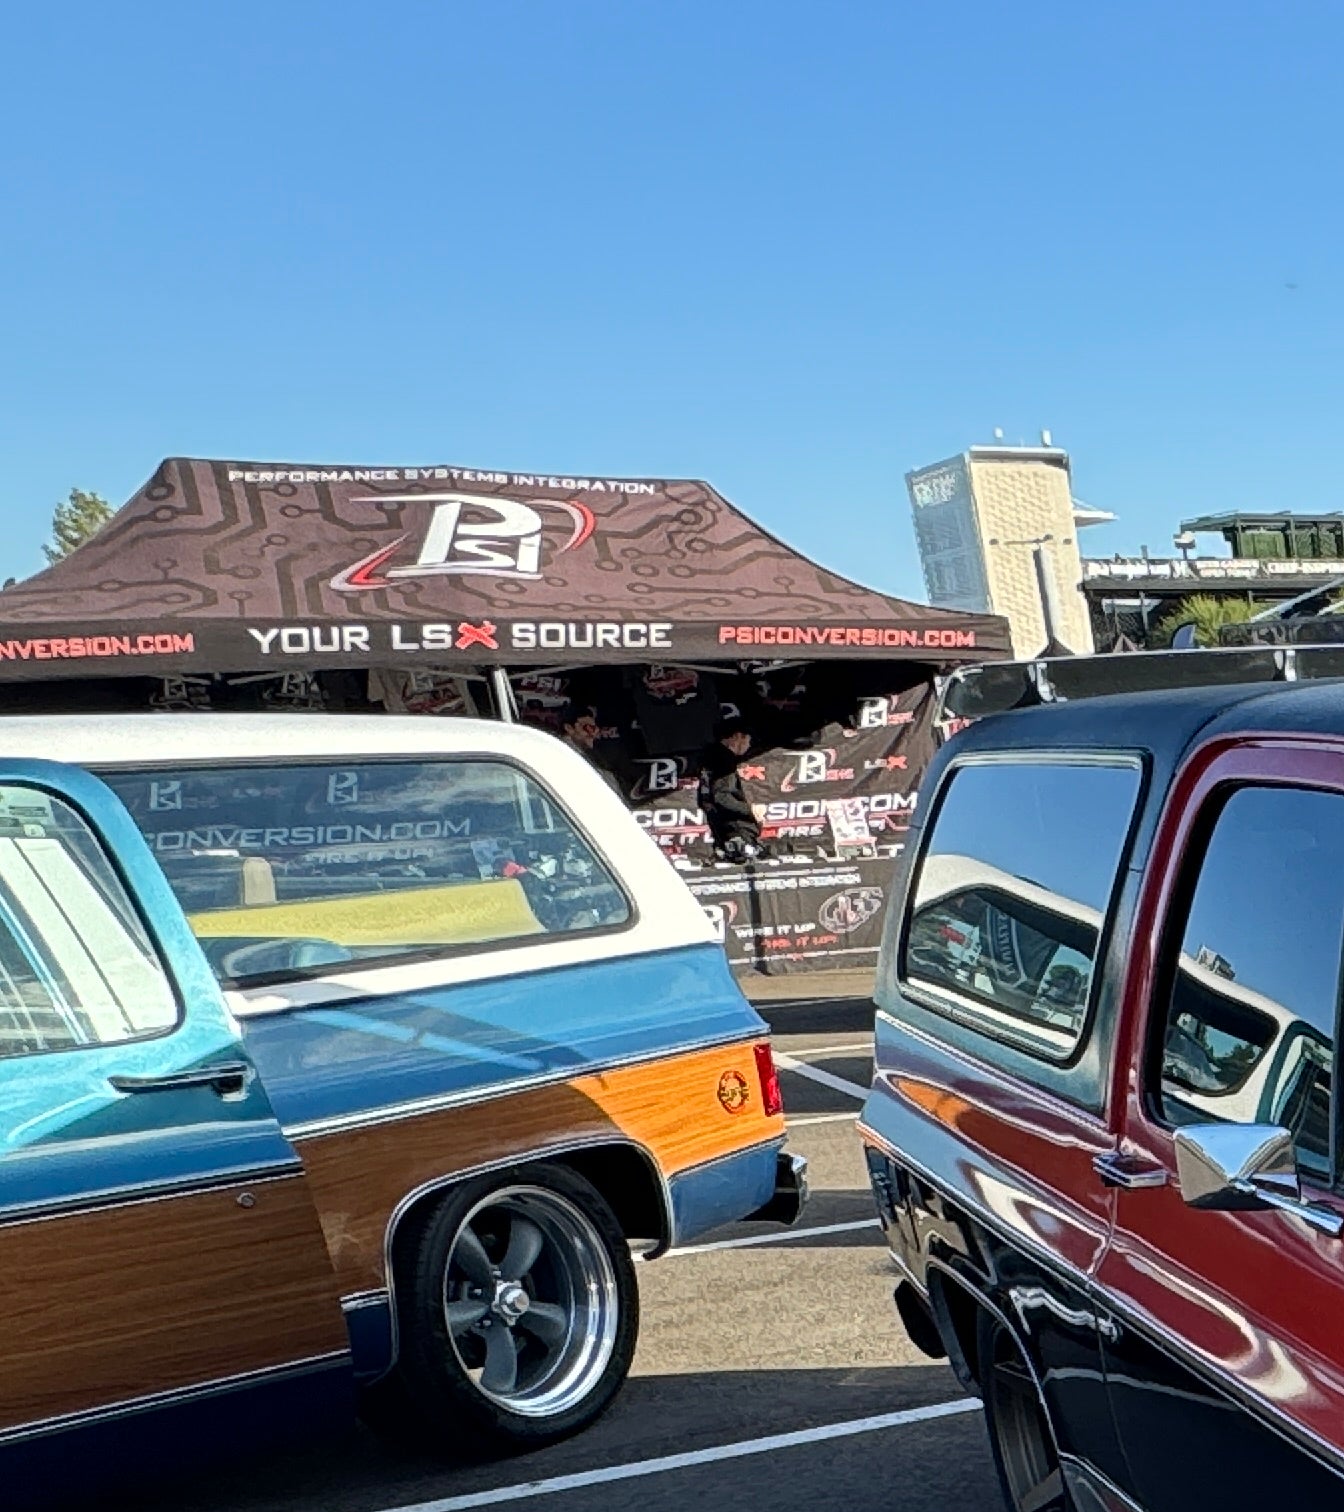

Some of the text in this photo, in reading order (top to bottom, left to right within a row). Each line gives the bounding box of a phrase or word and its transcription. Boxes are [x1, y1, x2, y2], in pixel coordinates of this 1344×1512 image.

[228, 468, 655, 494] PERFORMANCE SYSTEMS INTEGRATION
[247, 626, 370, 653] YOUR
[511, 622, 673, 649] SOURCE
[718, 626, 976, 647] PSICONVERSION.COM
